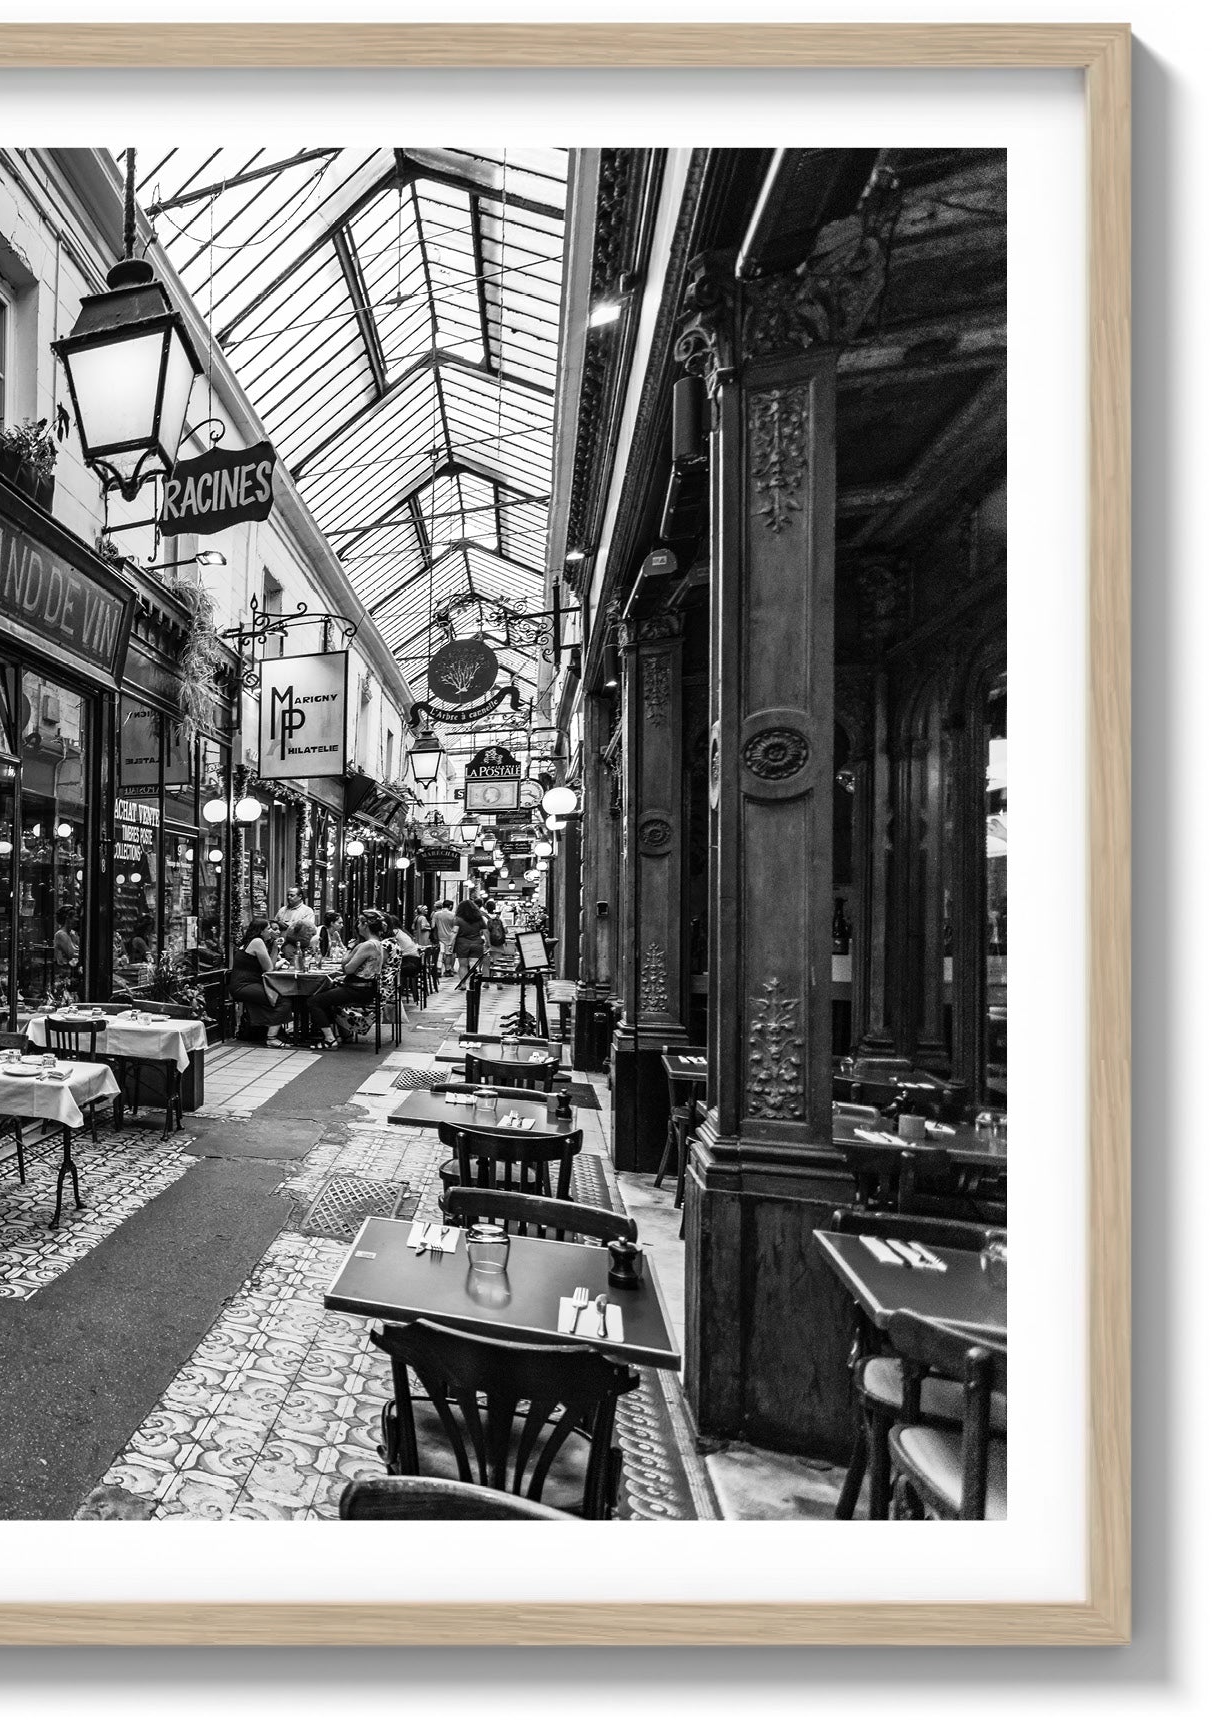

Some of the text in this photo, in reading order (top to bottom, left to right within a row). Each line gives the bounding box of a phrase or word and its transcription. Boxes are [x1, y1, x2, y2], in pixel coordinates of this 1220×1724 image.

[163, 461, 272, 521] RACINES
[44, 566, 81, 635] DE
[82, 590, 119, 658] VIN
[430, 708, 458, 720] L'Arbre
[469, 700, 498, 718] cannelle
[465, 767, 477, 776] LA
[479, 766, 520, 776] POSTALE
[114, 799, 160, 827] ACHAT VENTE
